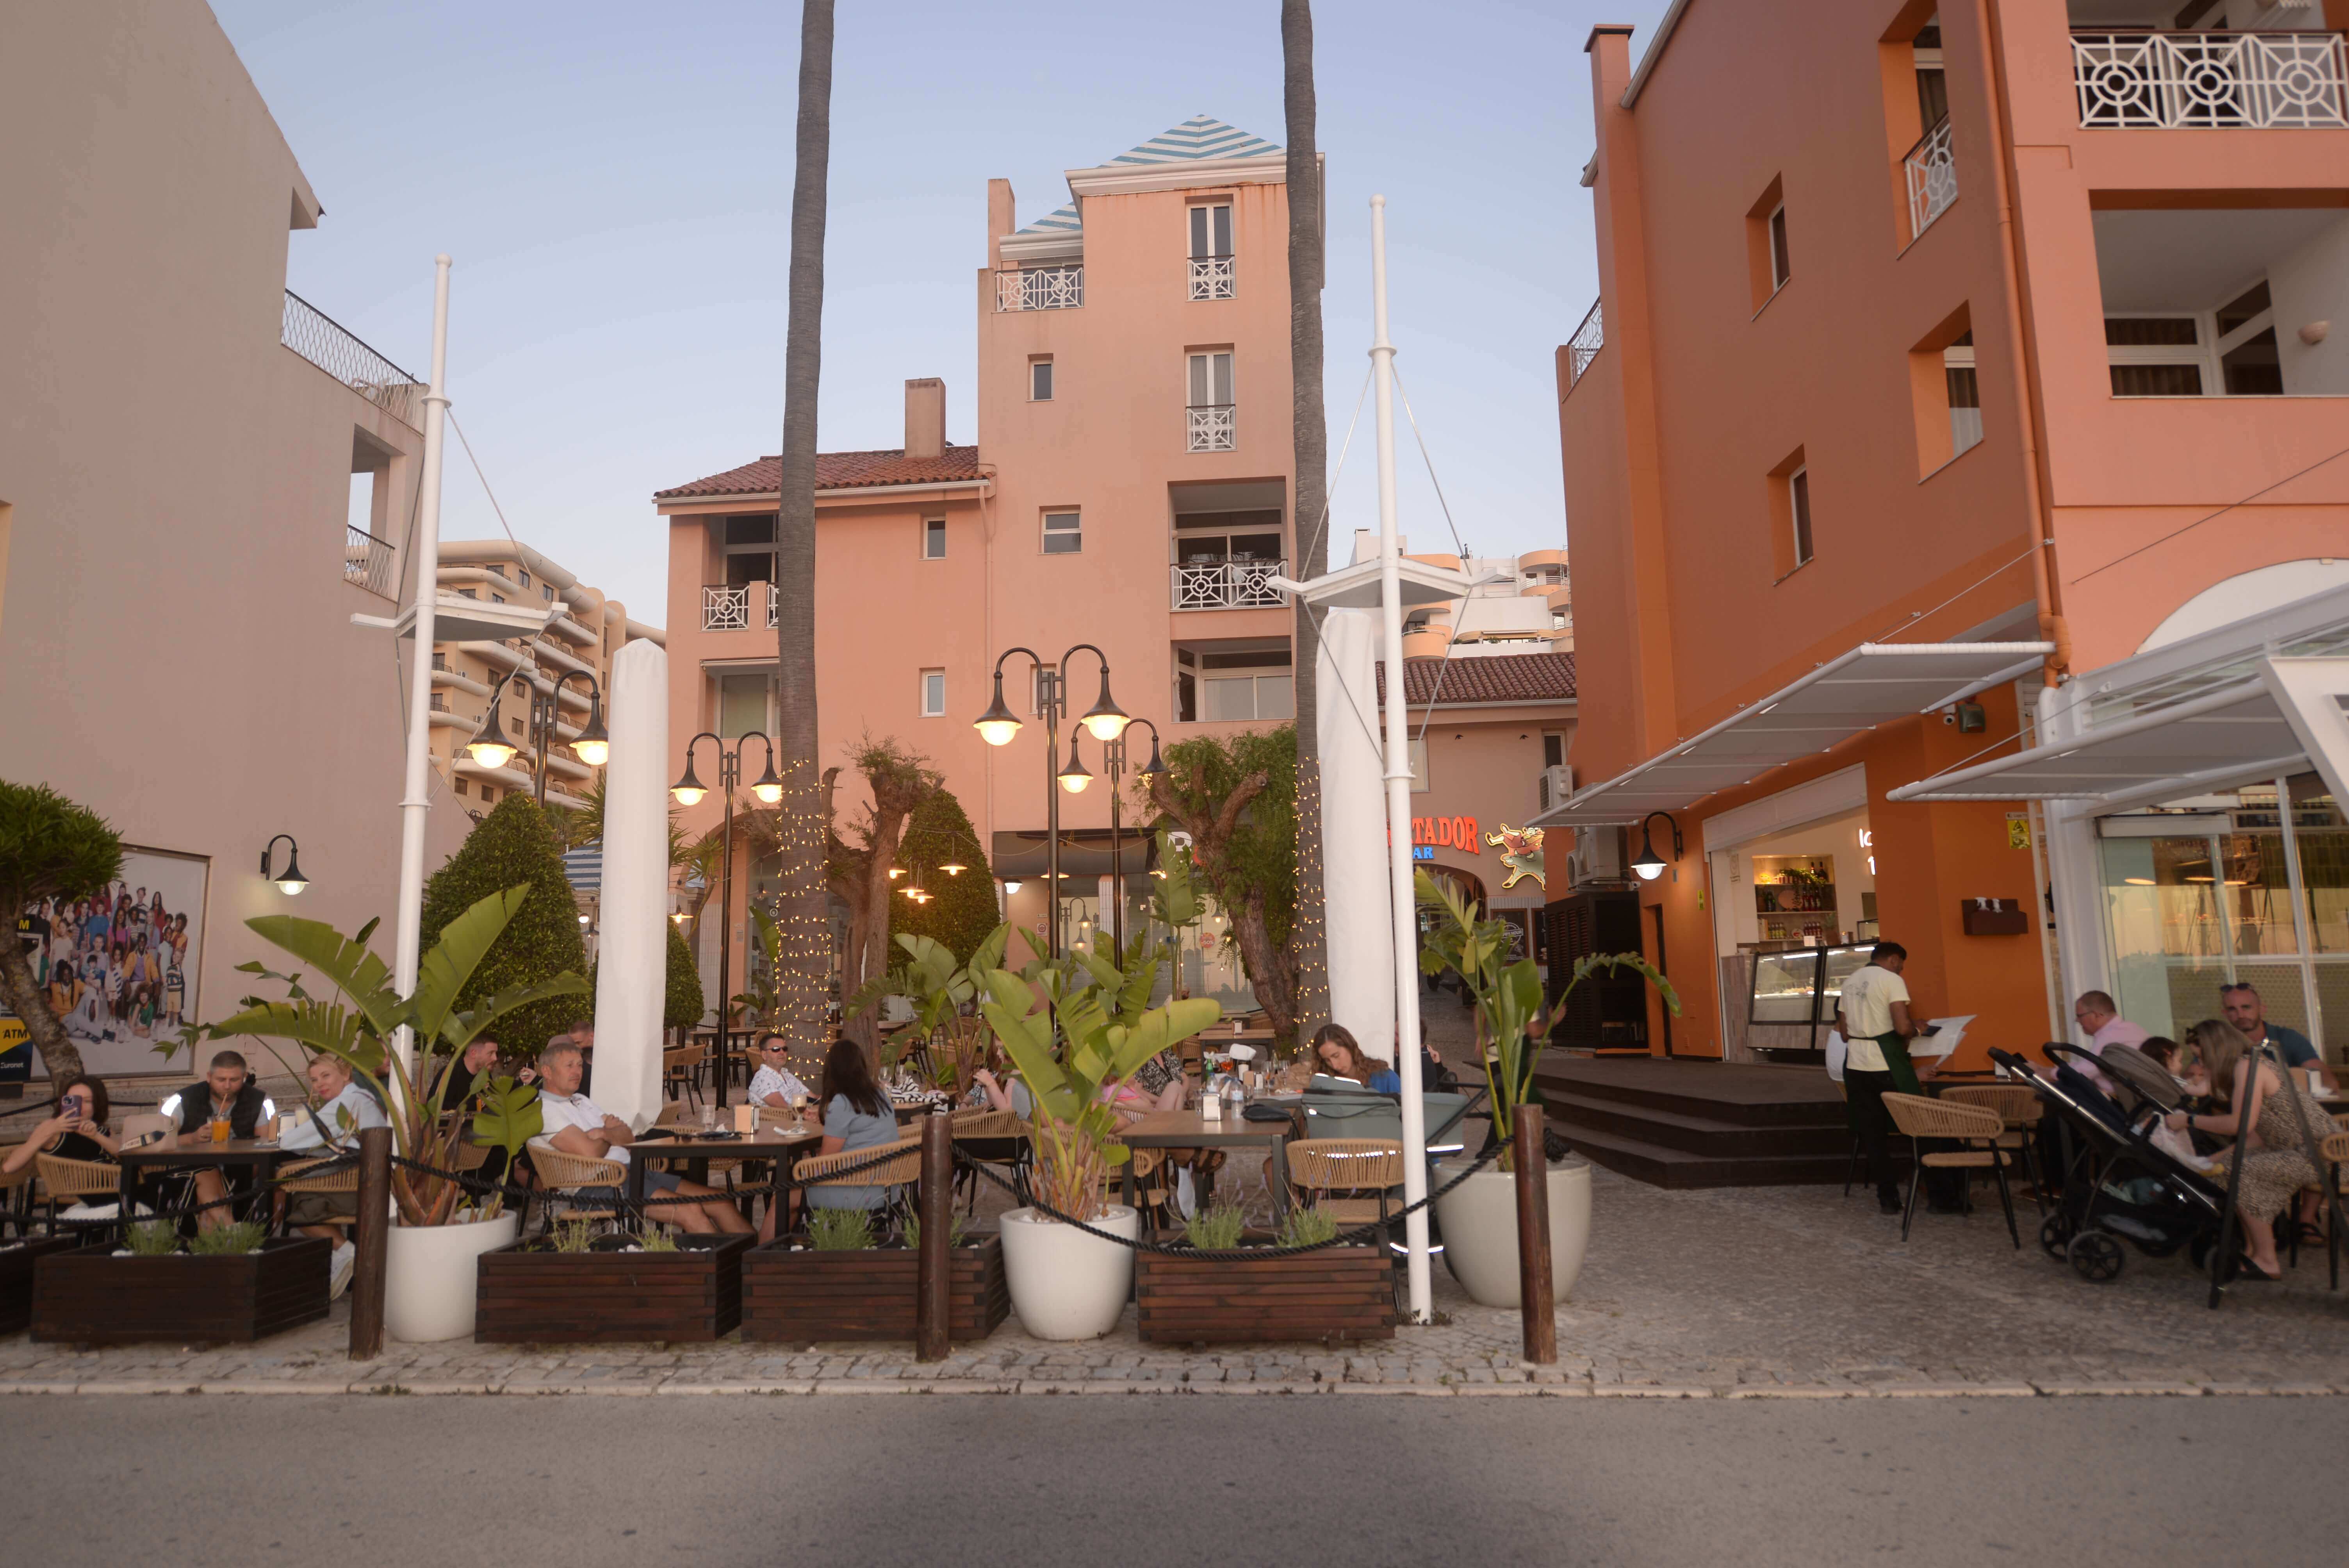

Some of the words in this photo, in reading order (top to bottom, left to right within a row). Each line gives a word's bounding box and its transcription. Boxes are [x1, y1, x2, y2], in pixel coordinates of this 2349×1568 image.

[1387, 816, 1479, 855] TADOR
[1412, 846, 1434, 859] AR
[3, 1029, 27, 1039] ATM
